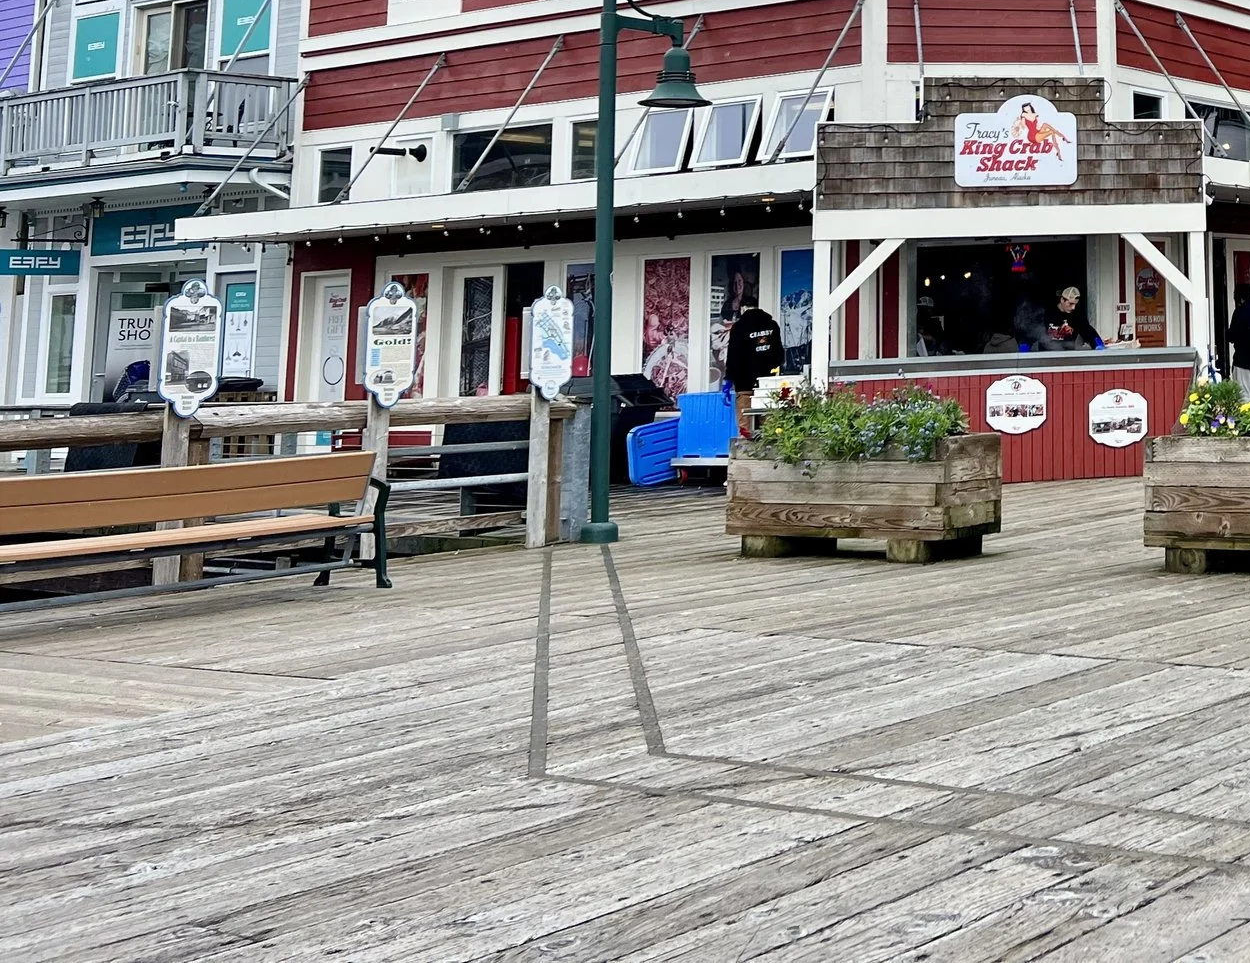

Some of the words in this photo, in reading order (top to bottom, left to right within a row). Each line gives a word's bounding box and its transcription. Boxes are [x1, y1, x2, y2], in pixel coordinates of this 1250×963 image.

[965, 122, 1009, 142] Tracy's
[960, 140, 1007, 158] King
[1009, 139, 1053, 154] Crab
[976, 155, 1039, 172] Shack
[9, 256, 61, 269] EFFY
[118, 329, 151, 340] SHO
